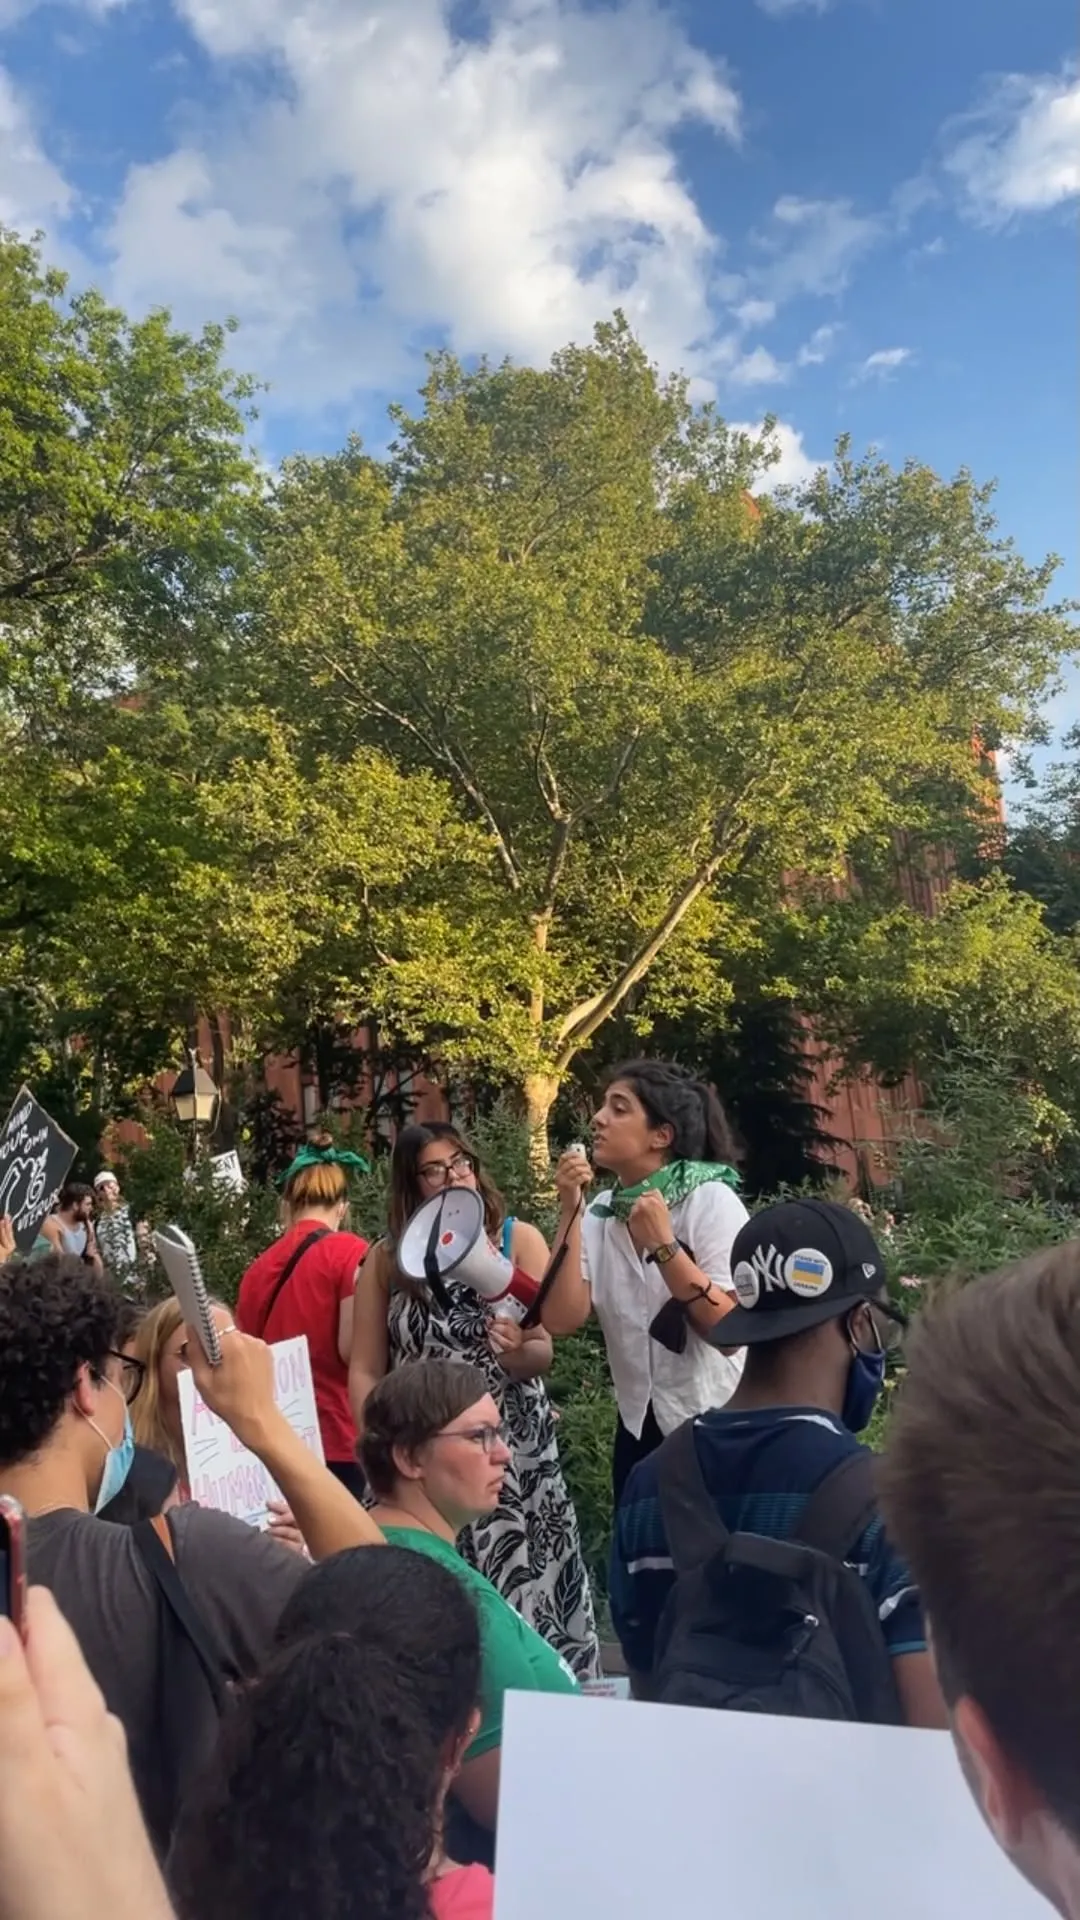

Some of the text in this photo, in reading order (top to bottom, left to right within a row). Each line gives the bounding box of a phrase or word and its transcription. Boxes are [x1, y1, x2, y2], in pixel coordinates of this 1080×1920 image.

[7, 1101, 32, 1136] MIND
[24, 1127, 49, 1154] OWN
[751, 1244, 786, 1292] NY
